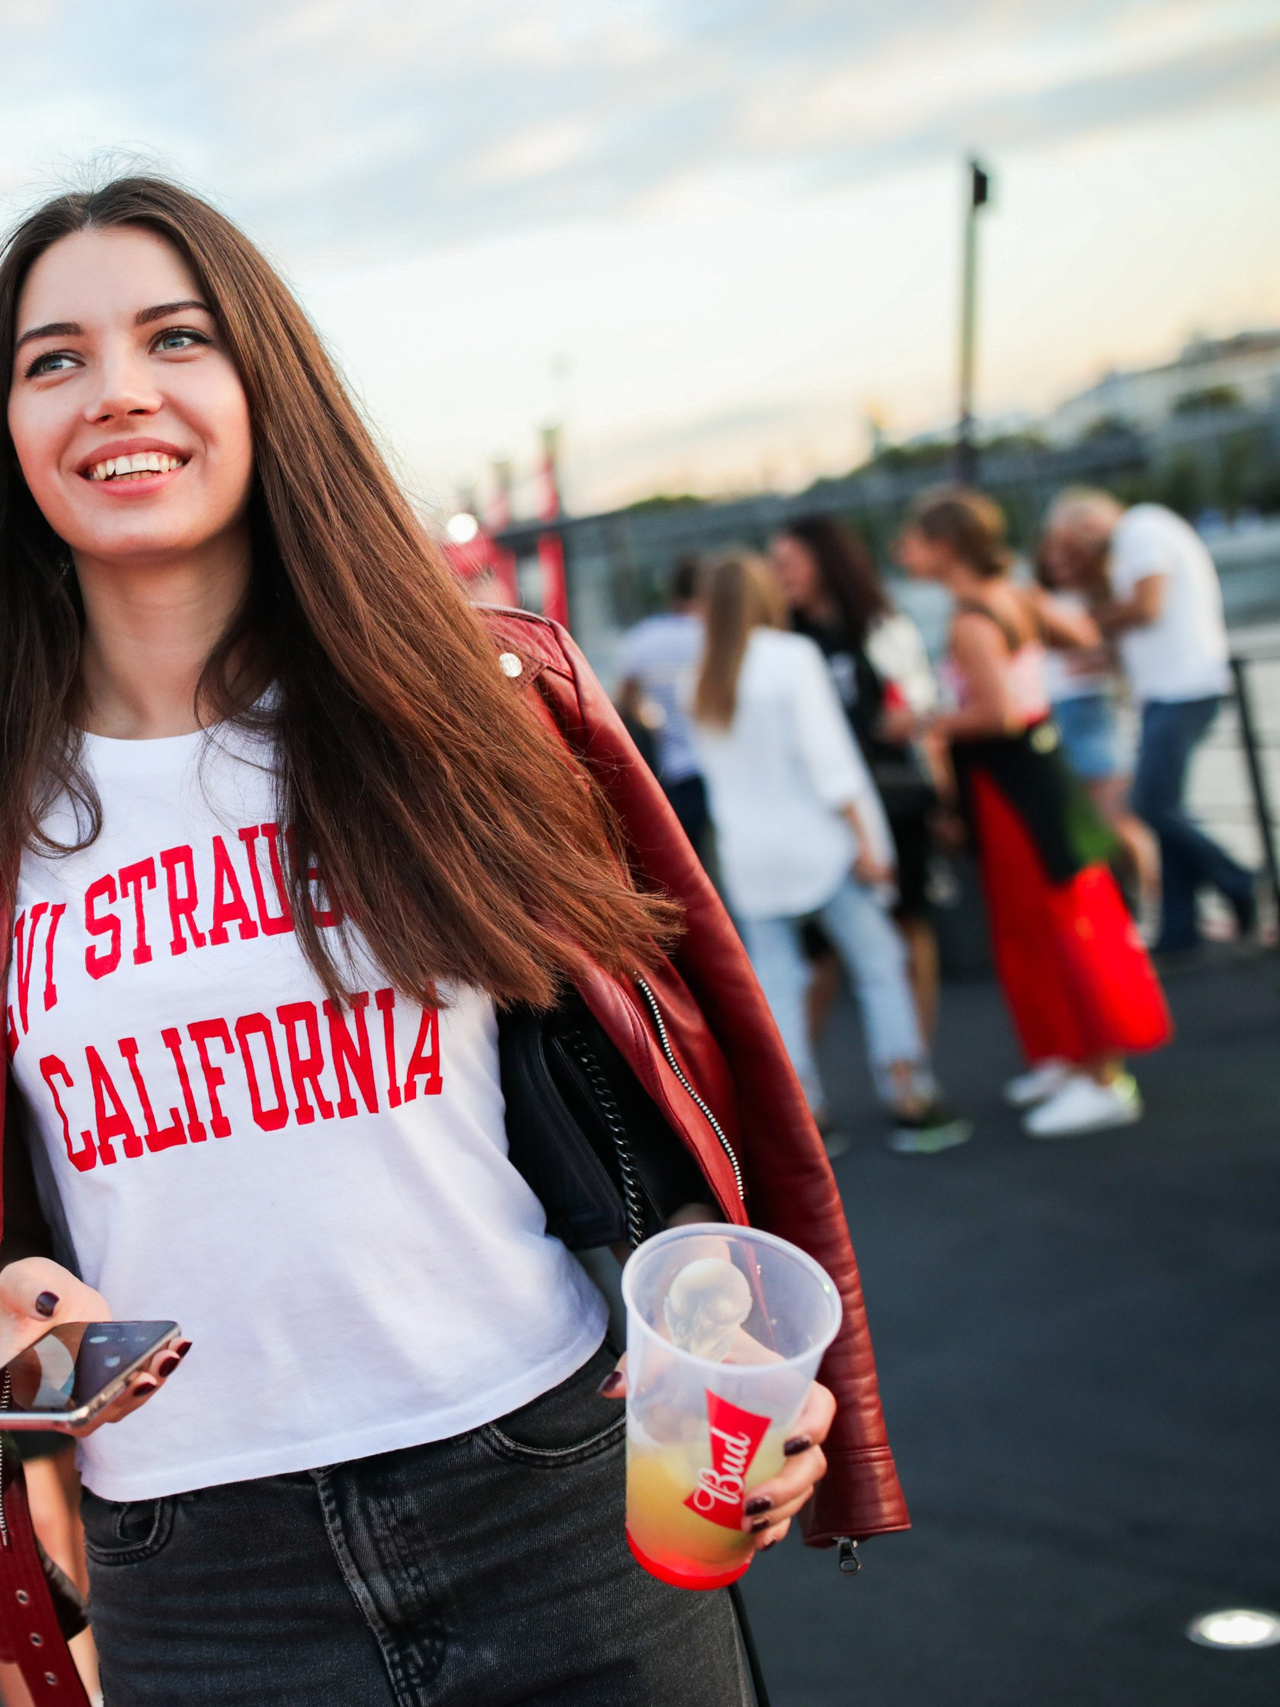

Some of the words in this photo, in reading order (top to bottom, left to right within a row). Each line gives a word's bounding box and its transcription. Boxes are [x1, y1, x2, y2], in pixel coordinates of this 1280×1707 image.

[7, 901, 67, 1065] VI
[39, 983, 443, 1173] CALIFORNIA
[693, 1426, 751, 1511] Bud
